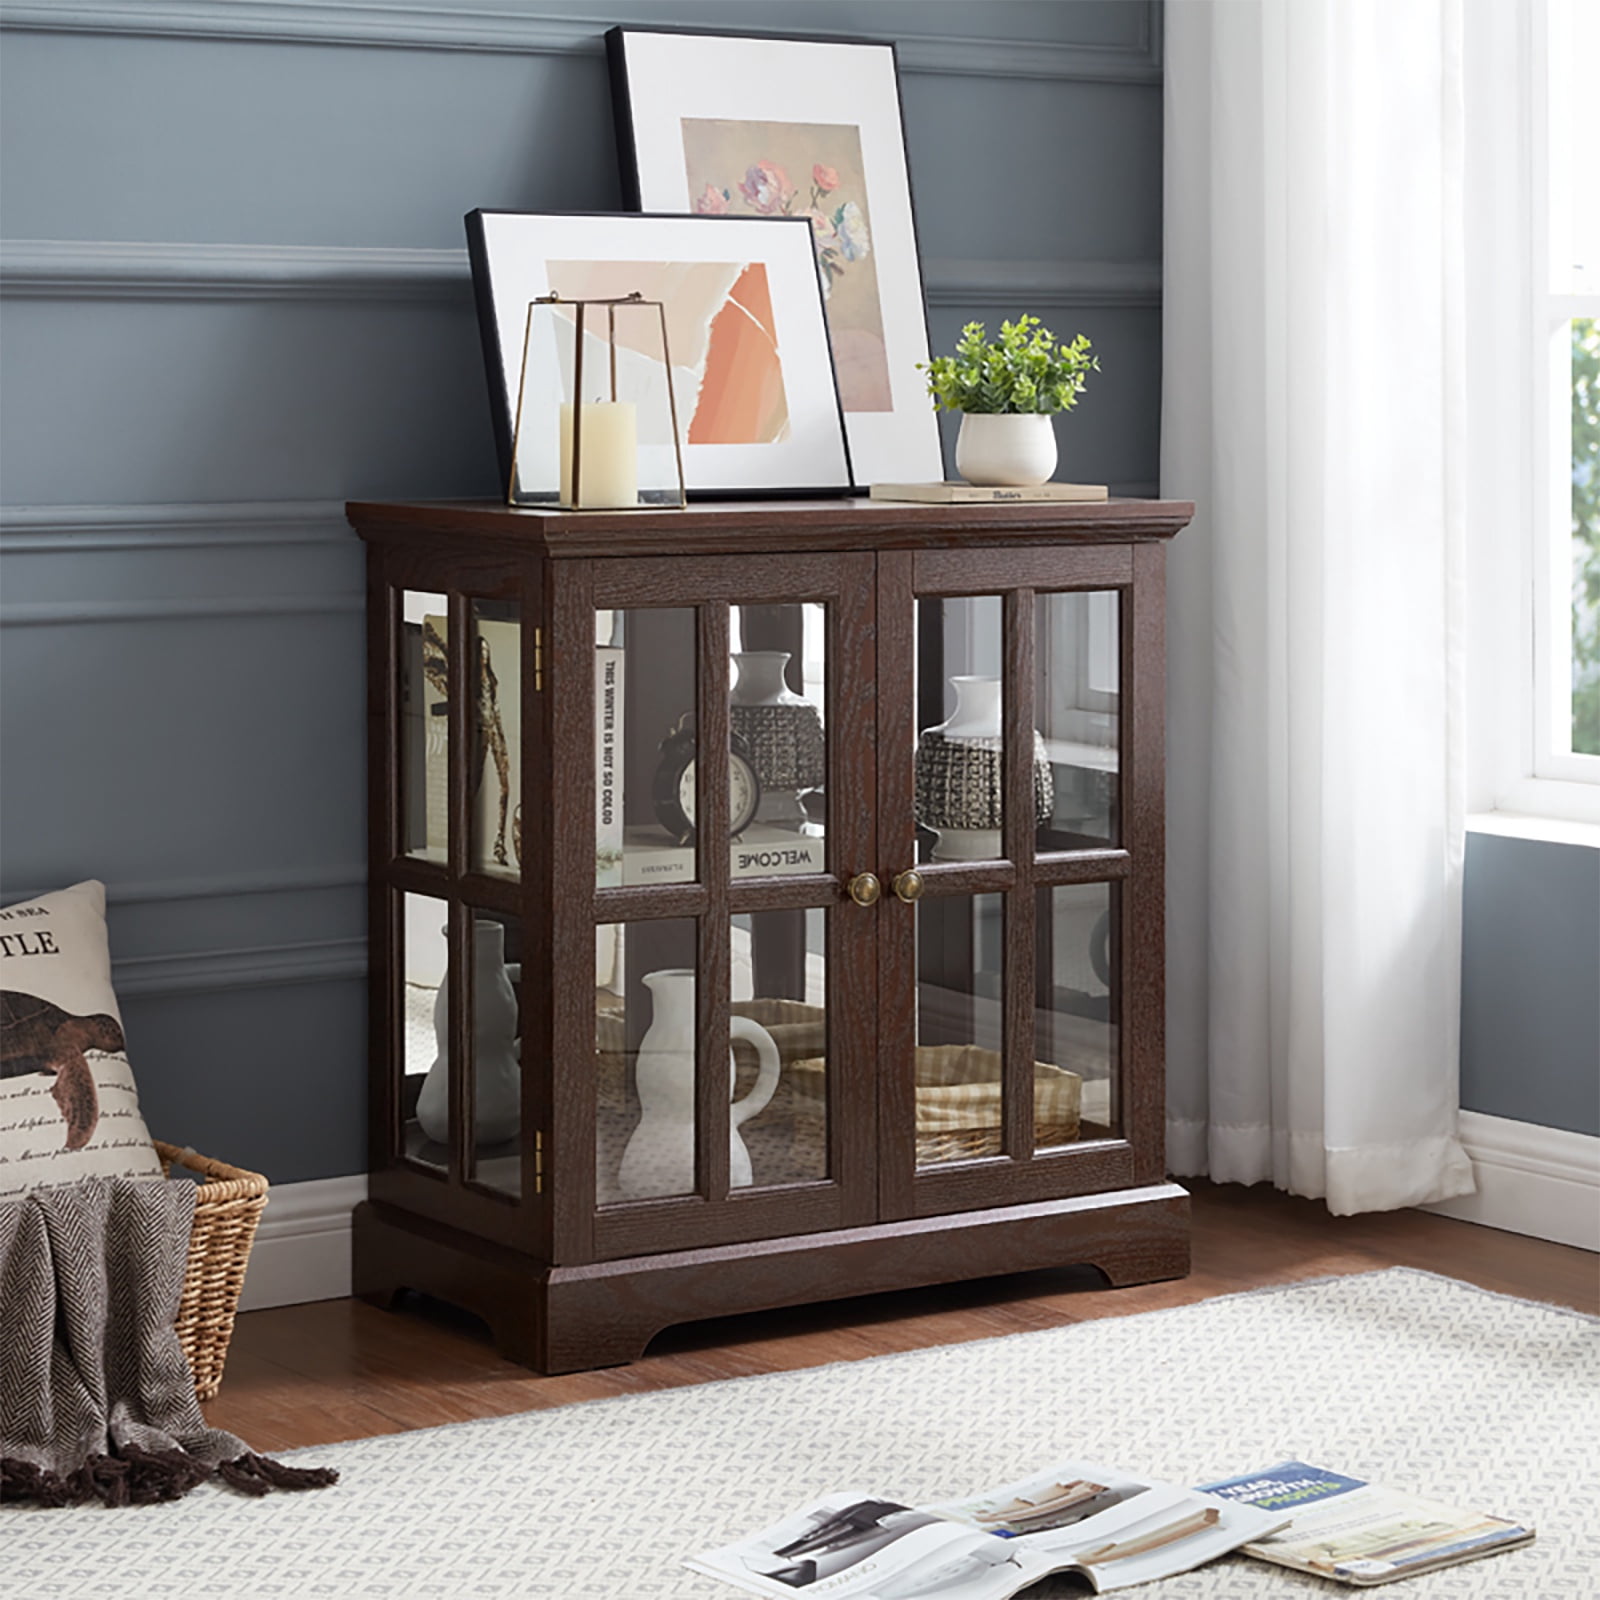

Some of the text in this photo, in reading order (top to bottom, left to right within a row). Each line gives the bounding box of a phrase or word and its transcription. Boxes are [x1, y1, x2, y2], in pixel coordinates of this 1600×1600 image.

[605, 660, 616, 686] THIS
[604, 687, 616, 730] WINTER
[603, 733, 614, 744] IS
[603, 746, 614, 769] NOT
[602, 772, 613, 787] SO
[738, 849, 812, 869] WELCOME
